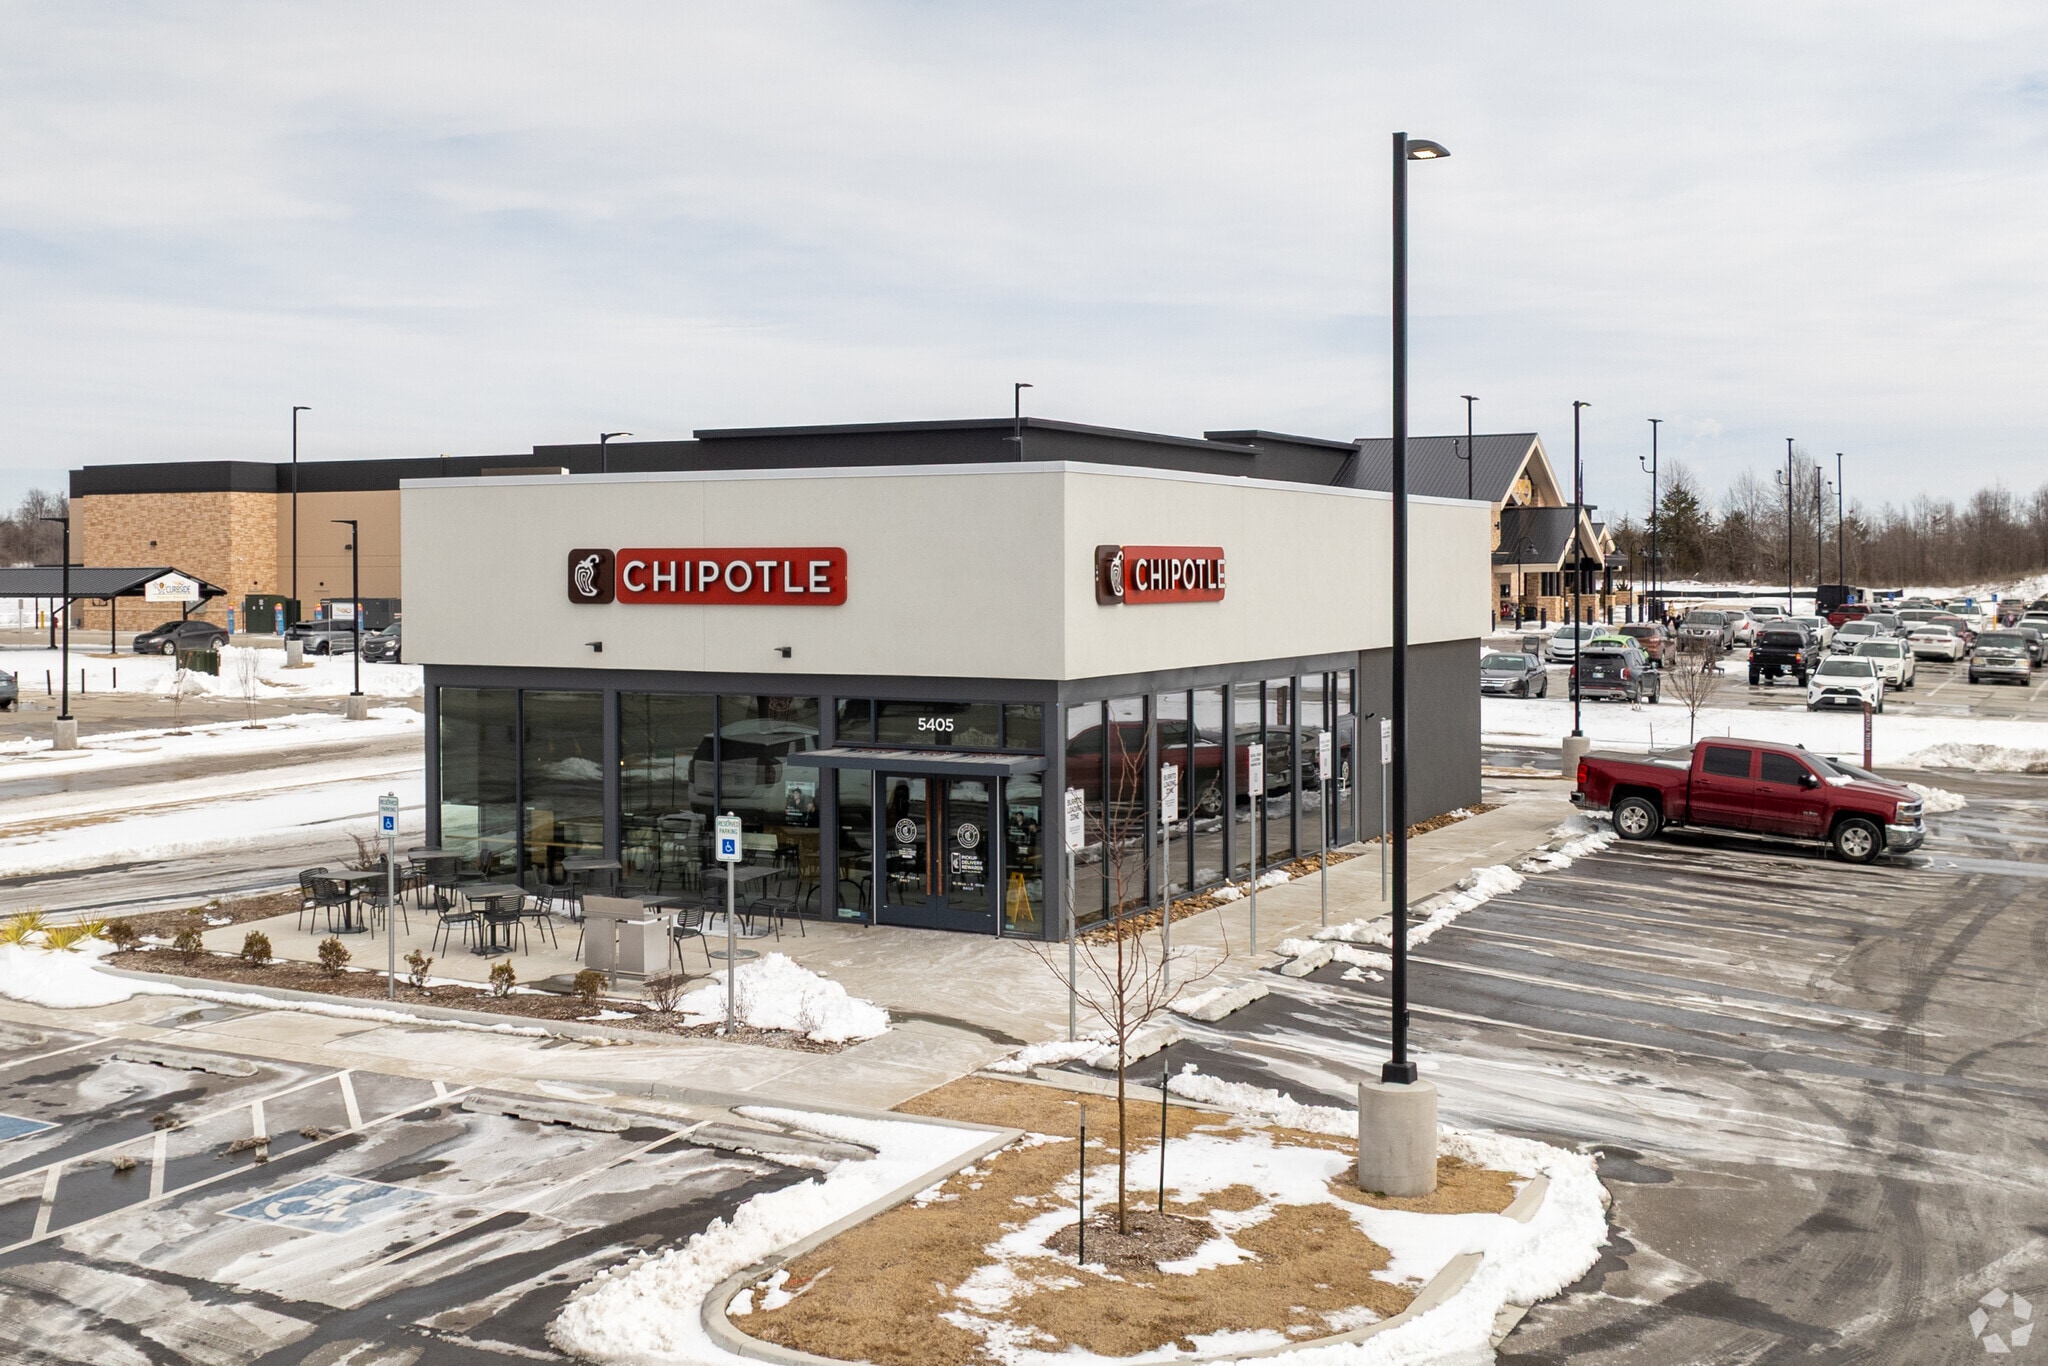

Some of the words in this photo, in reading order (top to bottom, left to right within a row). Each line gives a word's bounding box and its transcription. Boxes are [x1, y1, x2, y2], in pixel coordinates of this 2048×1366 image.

[622, 560, 831, 593] CHIPOTLE
[1135, 558, 1227, 590] CHIPOTLE
[918, 717, 954, 732] 5405
